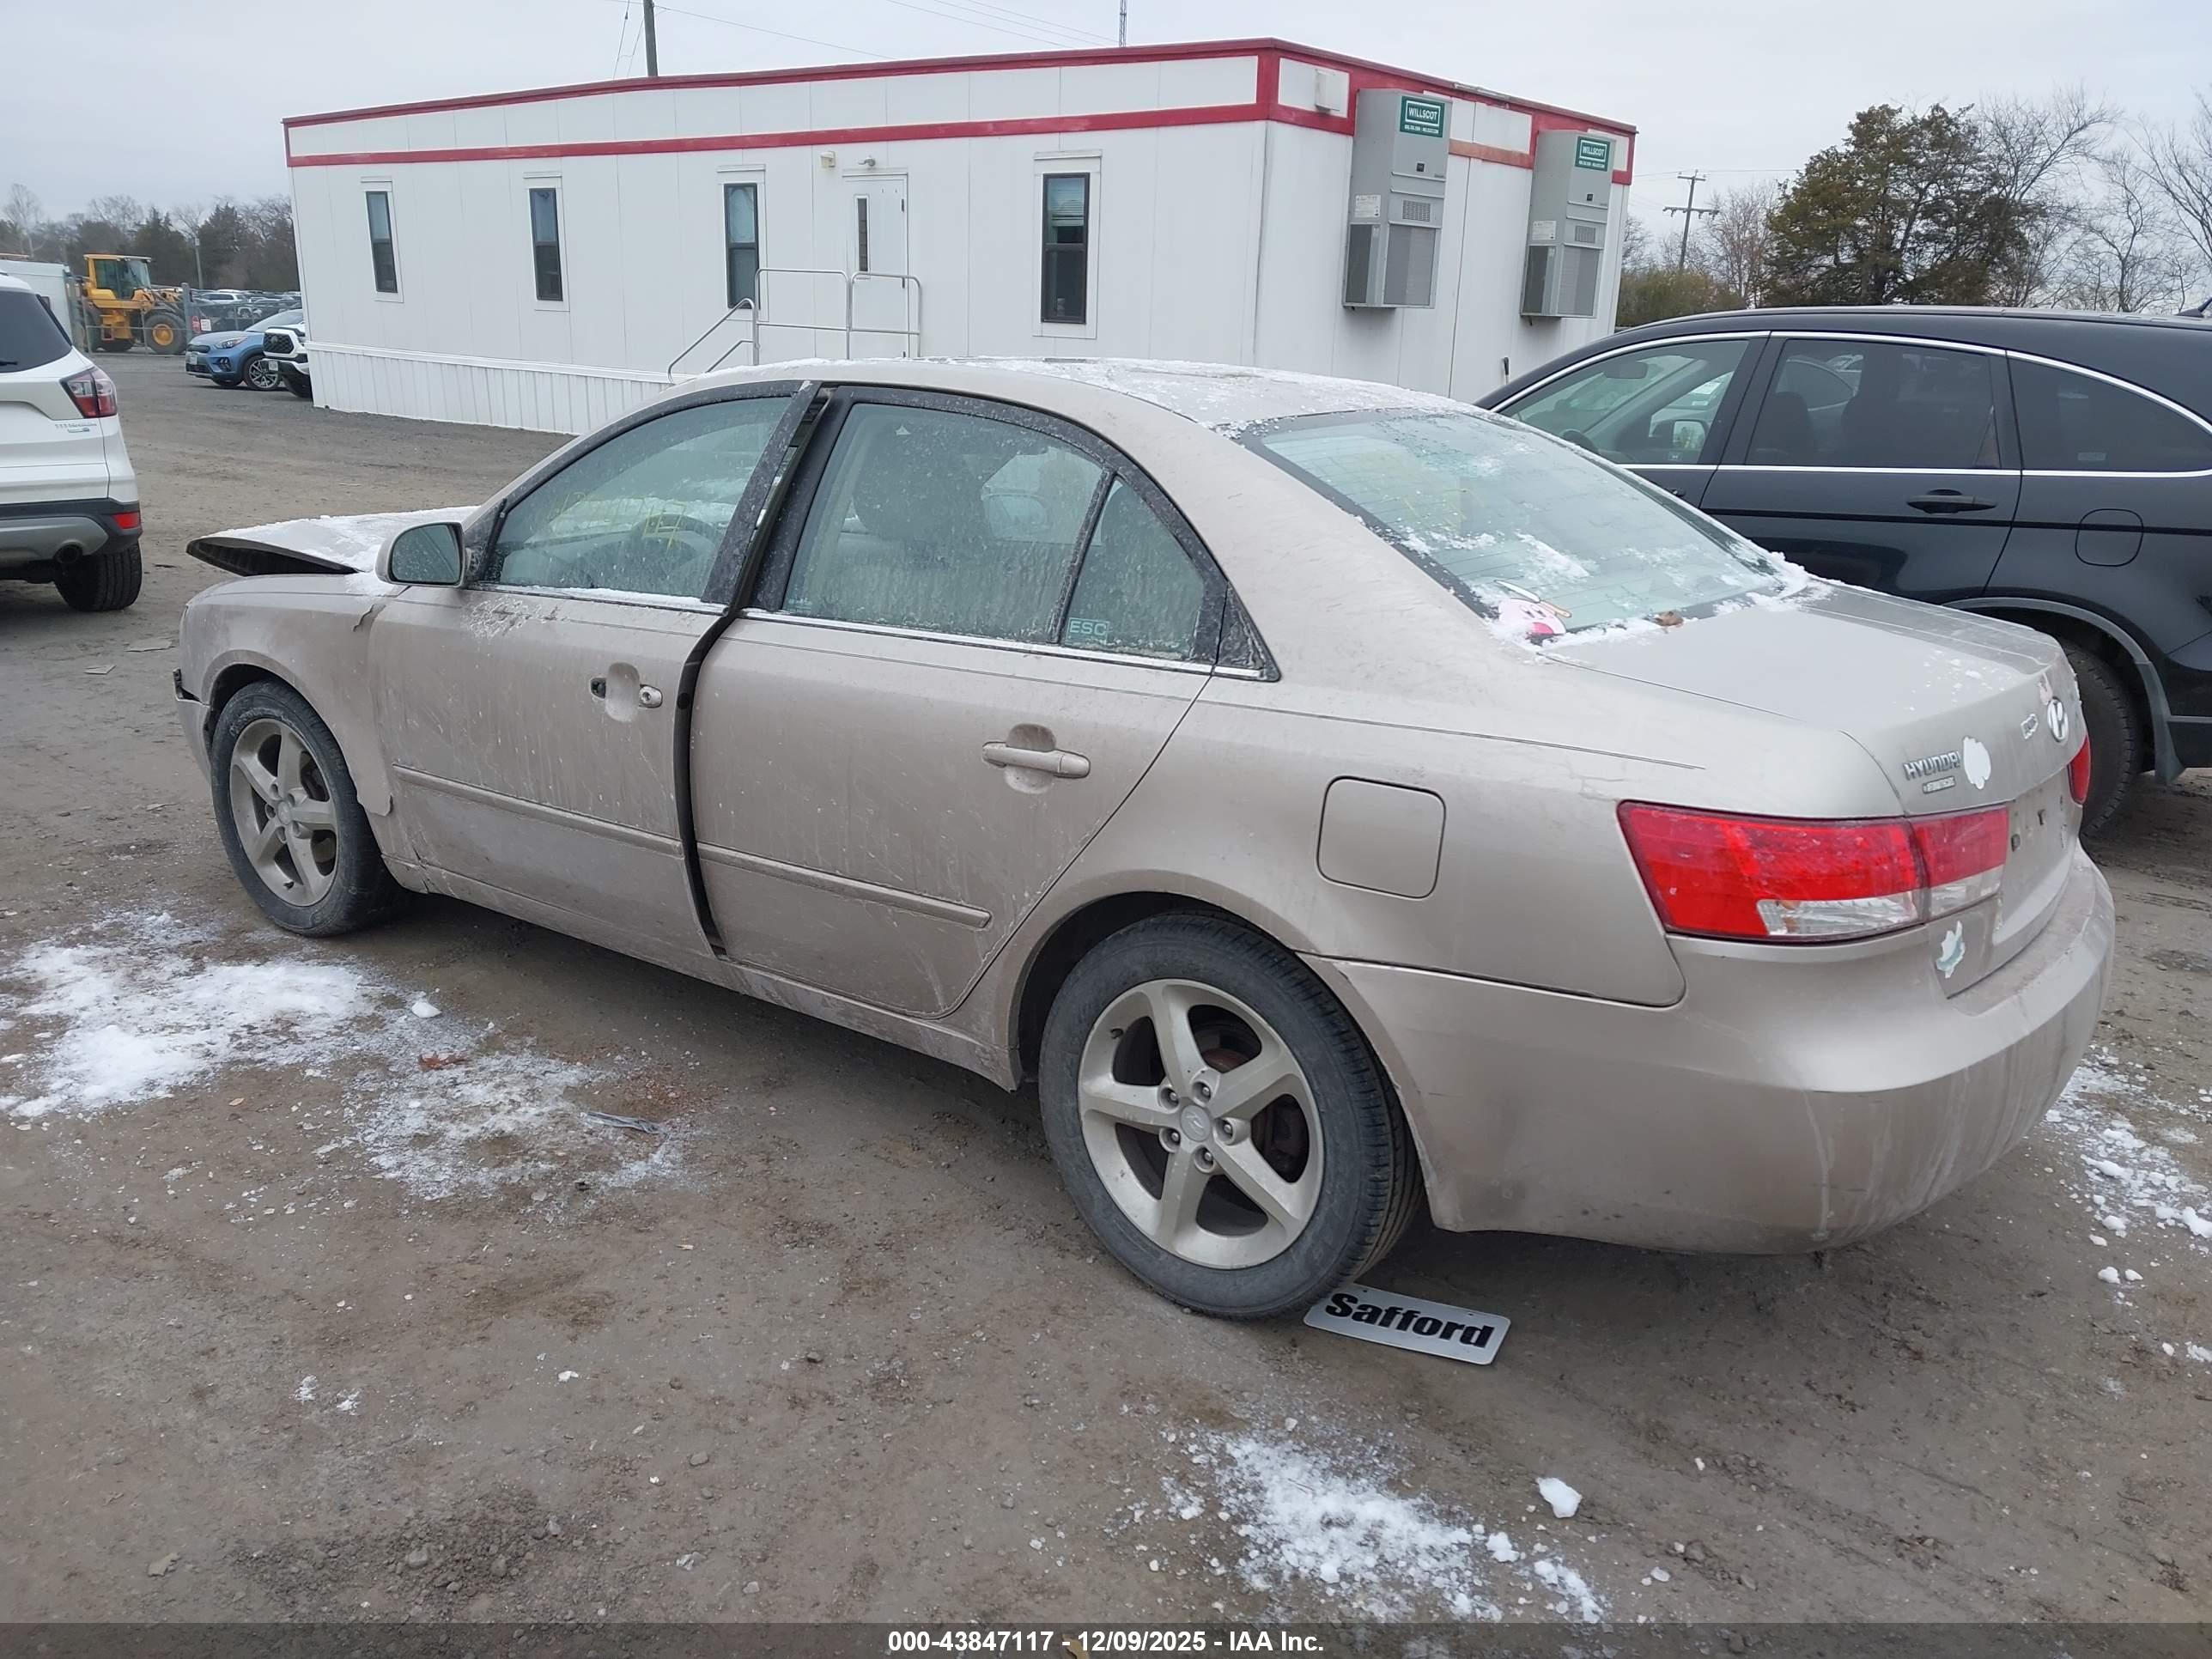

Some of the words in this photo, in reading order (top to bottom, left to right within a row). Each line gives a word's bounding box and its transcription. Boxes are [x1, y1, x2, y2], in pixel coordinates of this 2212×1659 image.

[1408, 106, 1437, 120] WILLSCOT
[1583, 146, 1605, 156] WILLSCOT
[1070, 620, 1107, 635] ESC
[1903, 750, 1960, 781] HYUNDAI
[1325, 1292, 1495, 1348] Safford
